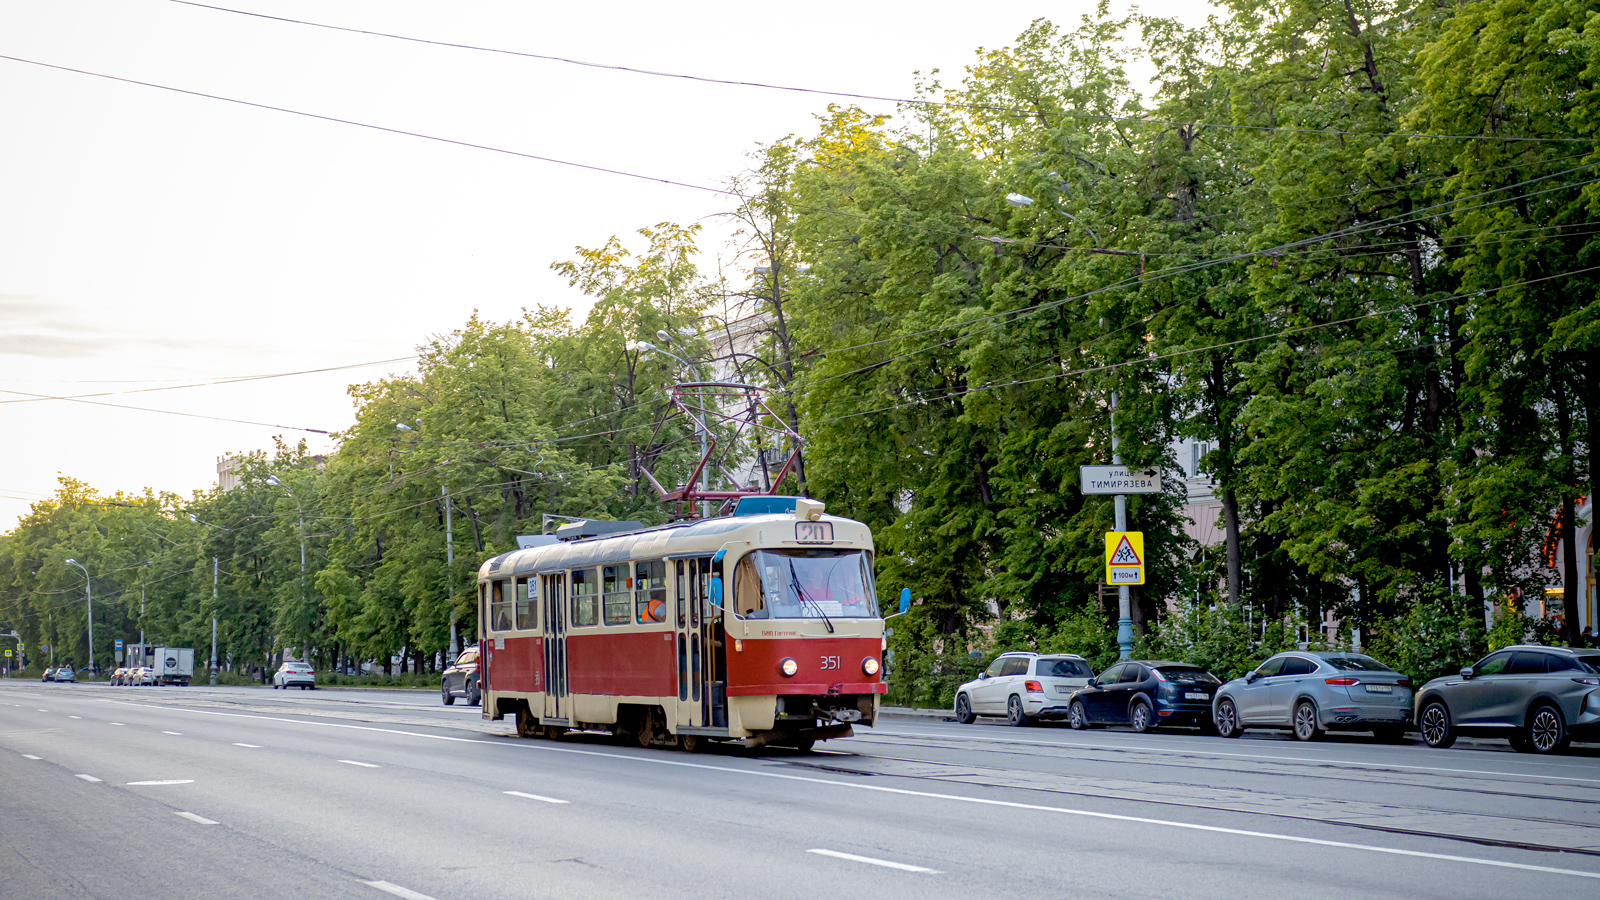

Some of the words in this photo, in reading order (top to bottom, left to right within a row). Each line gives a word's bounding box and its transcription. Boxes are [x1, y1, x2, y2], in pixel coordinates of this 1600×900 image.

[1091, 480, 1152, 489] ТИМИРЯЗЕВА
[802, 524, 824, 544] 20
[529, 579, 537, 593] 351
[820, 655, 841, 670] 351
